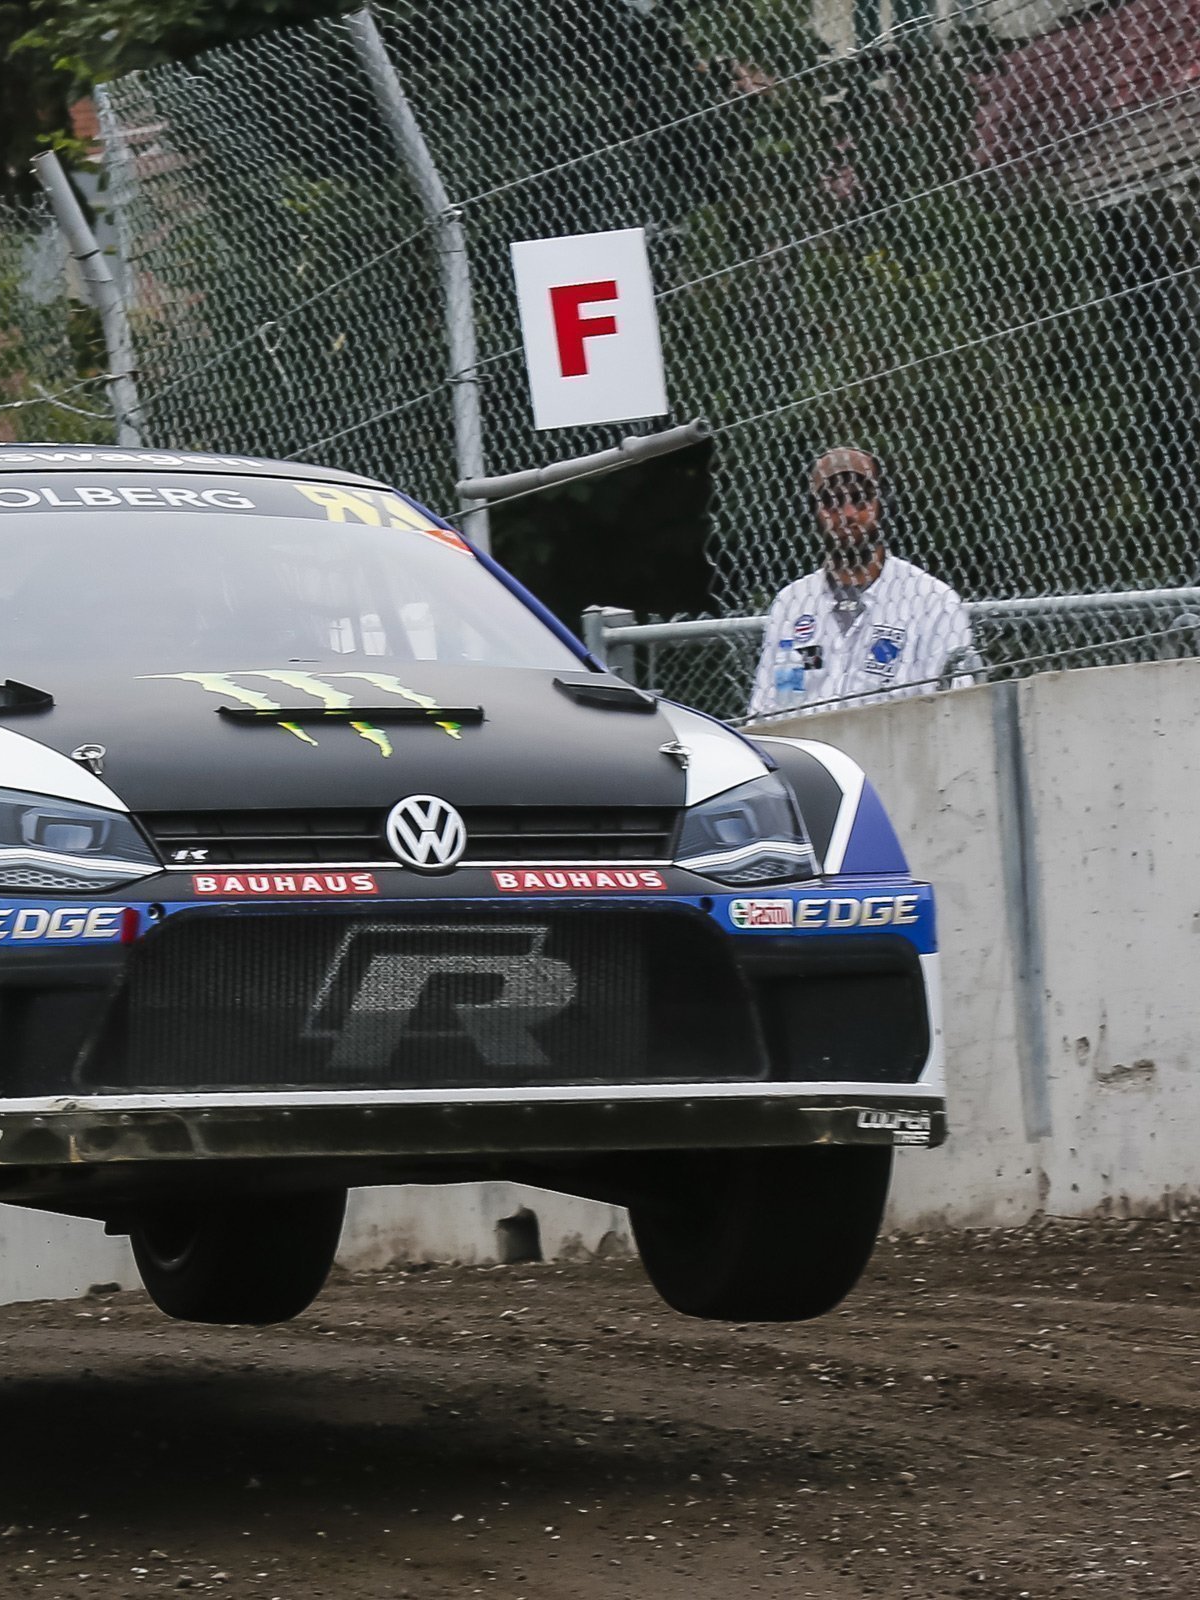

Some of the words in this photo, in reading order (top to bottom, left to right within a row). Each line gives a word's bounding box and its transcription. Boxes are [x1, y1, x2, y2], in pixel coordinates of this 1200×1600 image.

[549, 280, 619, 377] F
[195, 875, 374, 892] BAUHAUS
[495, 871, 664, 889] BAUHAUS
[796, 895, 920, 927] EDGE
[322, 947, 578, 1068] R
